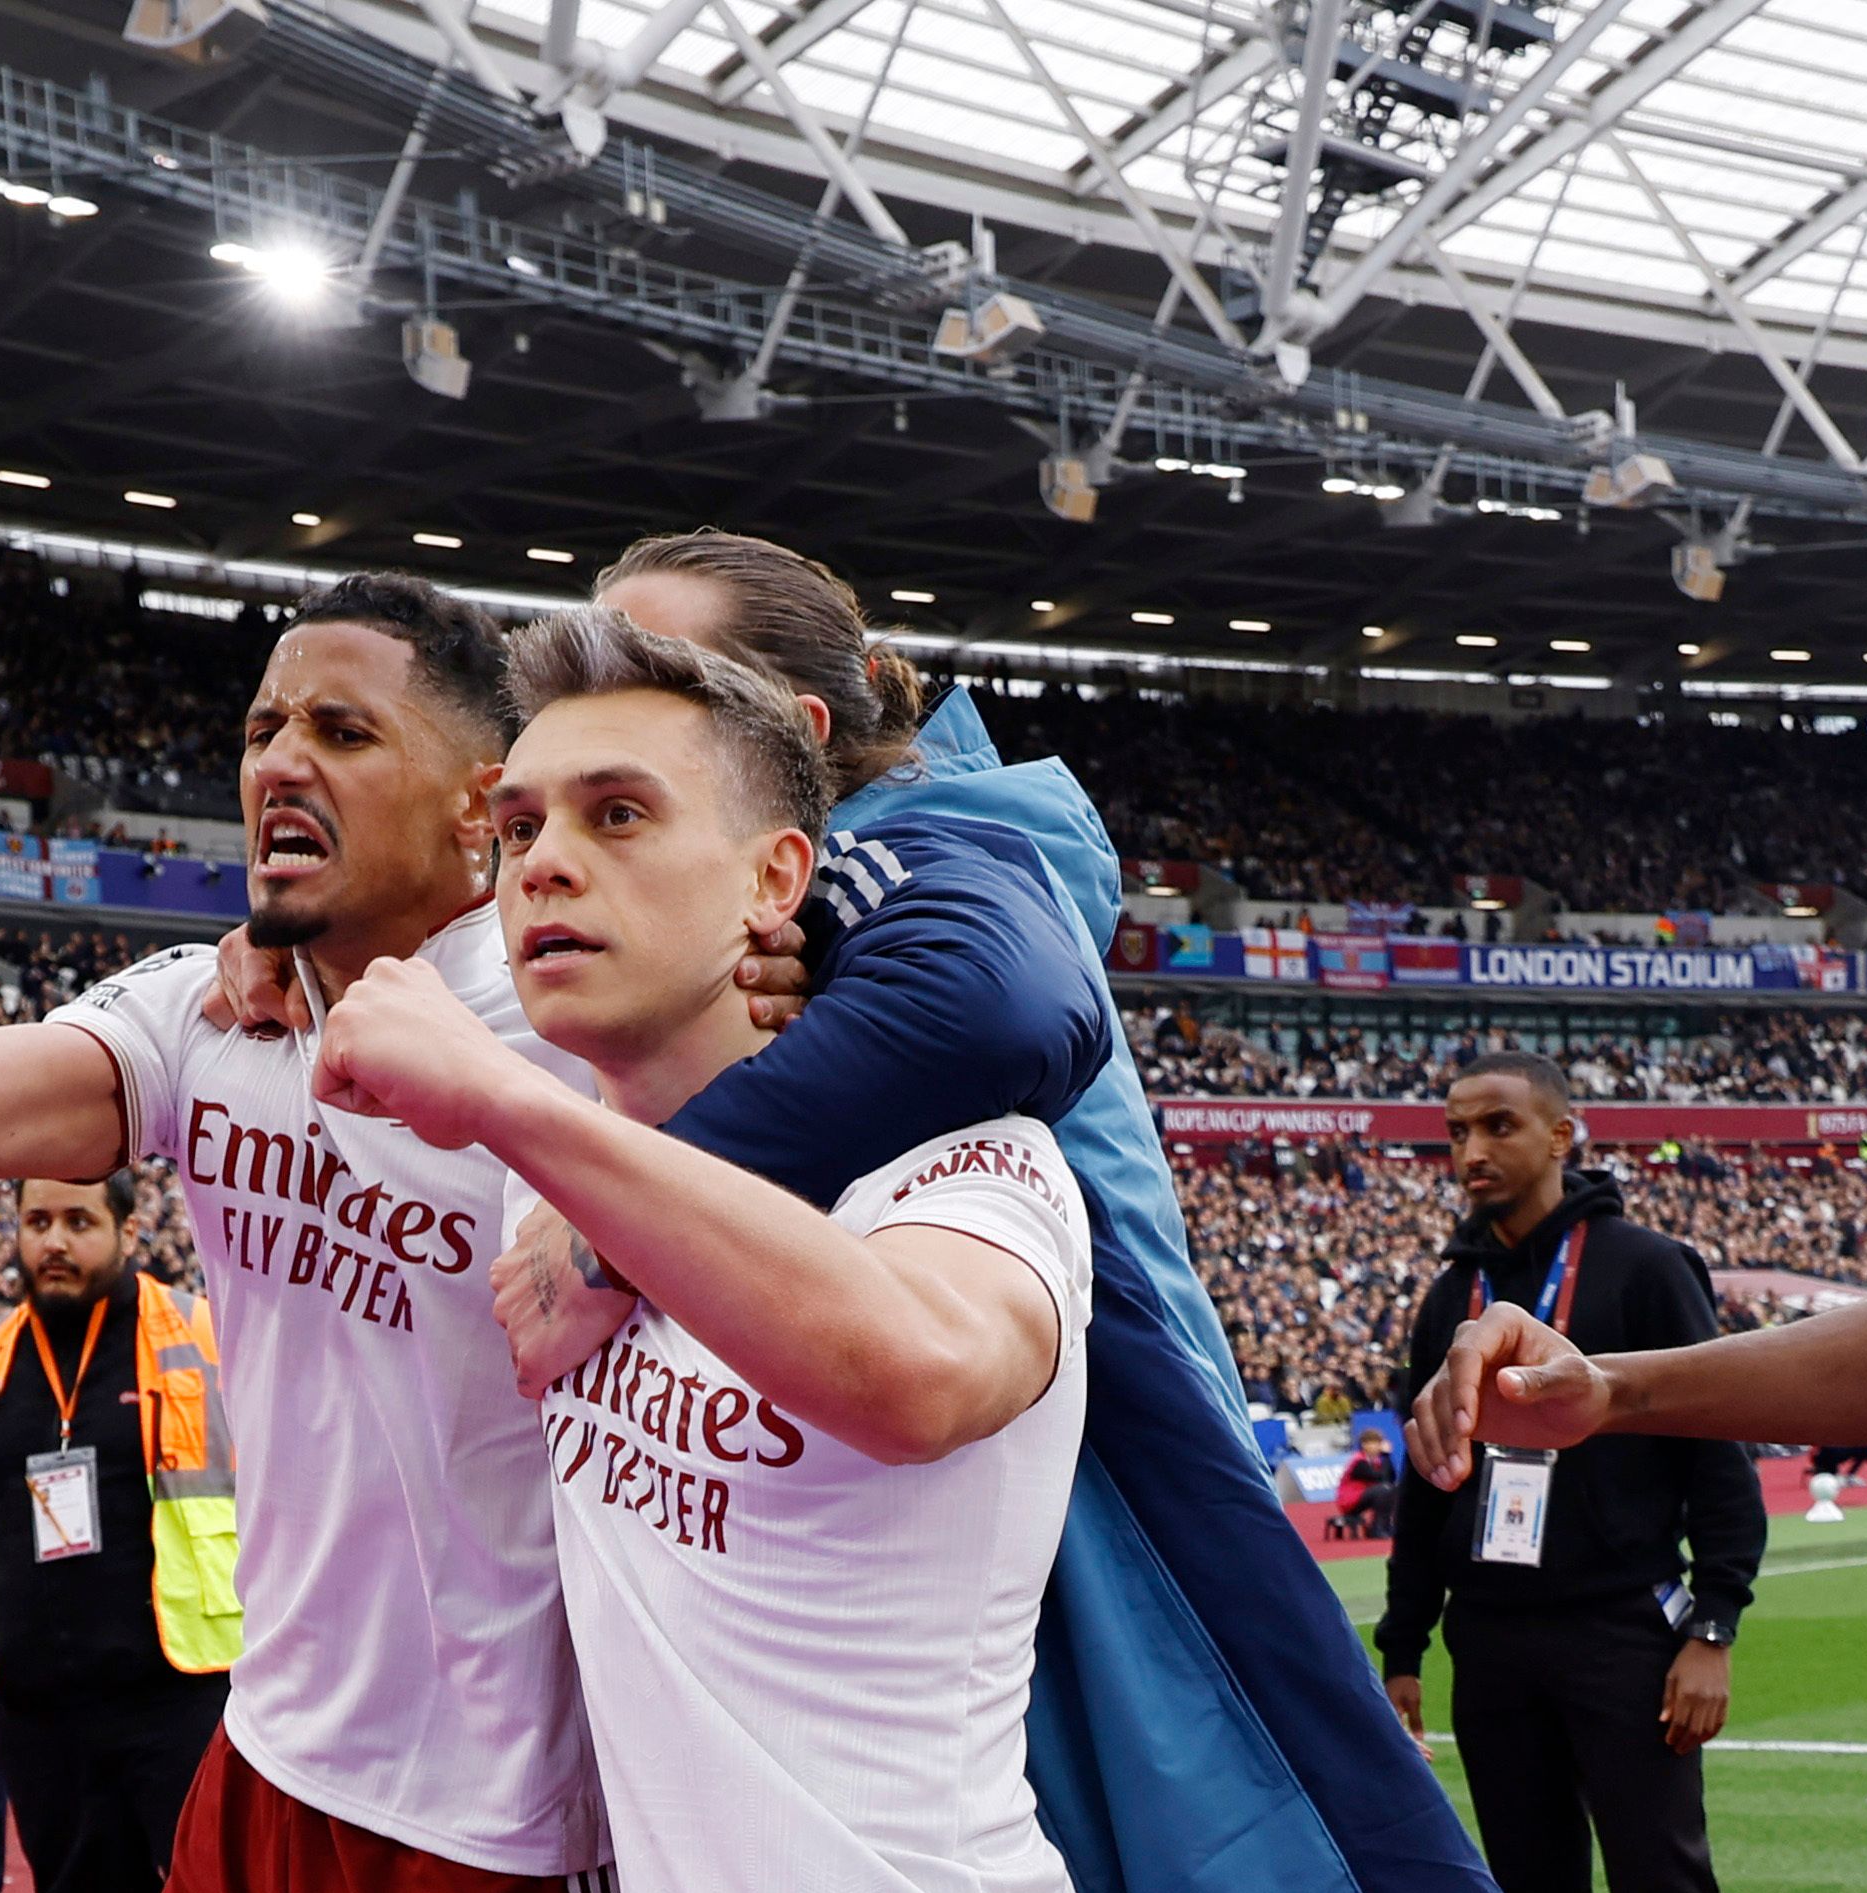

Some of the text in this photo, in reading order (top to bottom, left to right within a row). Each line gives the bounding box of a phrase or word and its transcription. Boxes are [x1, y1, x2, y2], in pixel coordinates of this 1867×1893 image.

[1470, 948, 1755, 988] LONDON STADIUM
[1163, 1107, 1230, 1132] ROPEAN
[188, 1098, 476, 1275] Emirates
[223, 1206, 284, 1276] FLY
[550, 1323, 805, 1469] mirates
